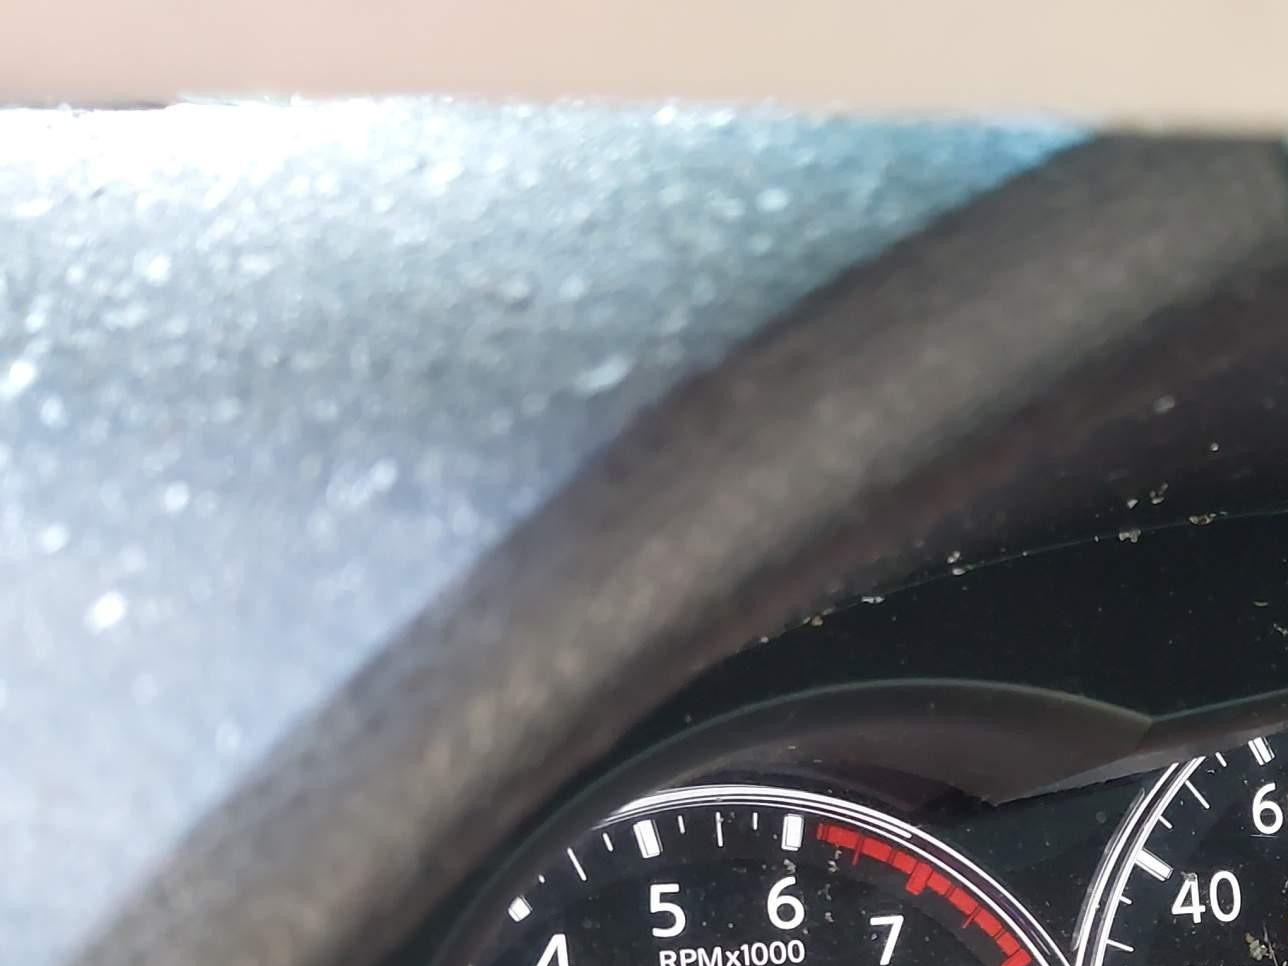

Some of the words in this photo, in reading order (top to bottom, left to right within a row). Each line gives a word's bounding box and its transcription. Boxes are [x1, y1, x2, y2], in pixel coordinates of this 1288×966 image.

[649, 883, 686, 938] 5
[767, 875, 805, 930] 6
[1171, 869, 1241, 923] 40
[869, 914, 905, 966] 7
